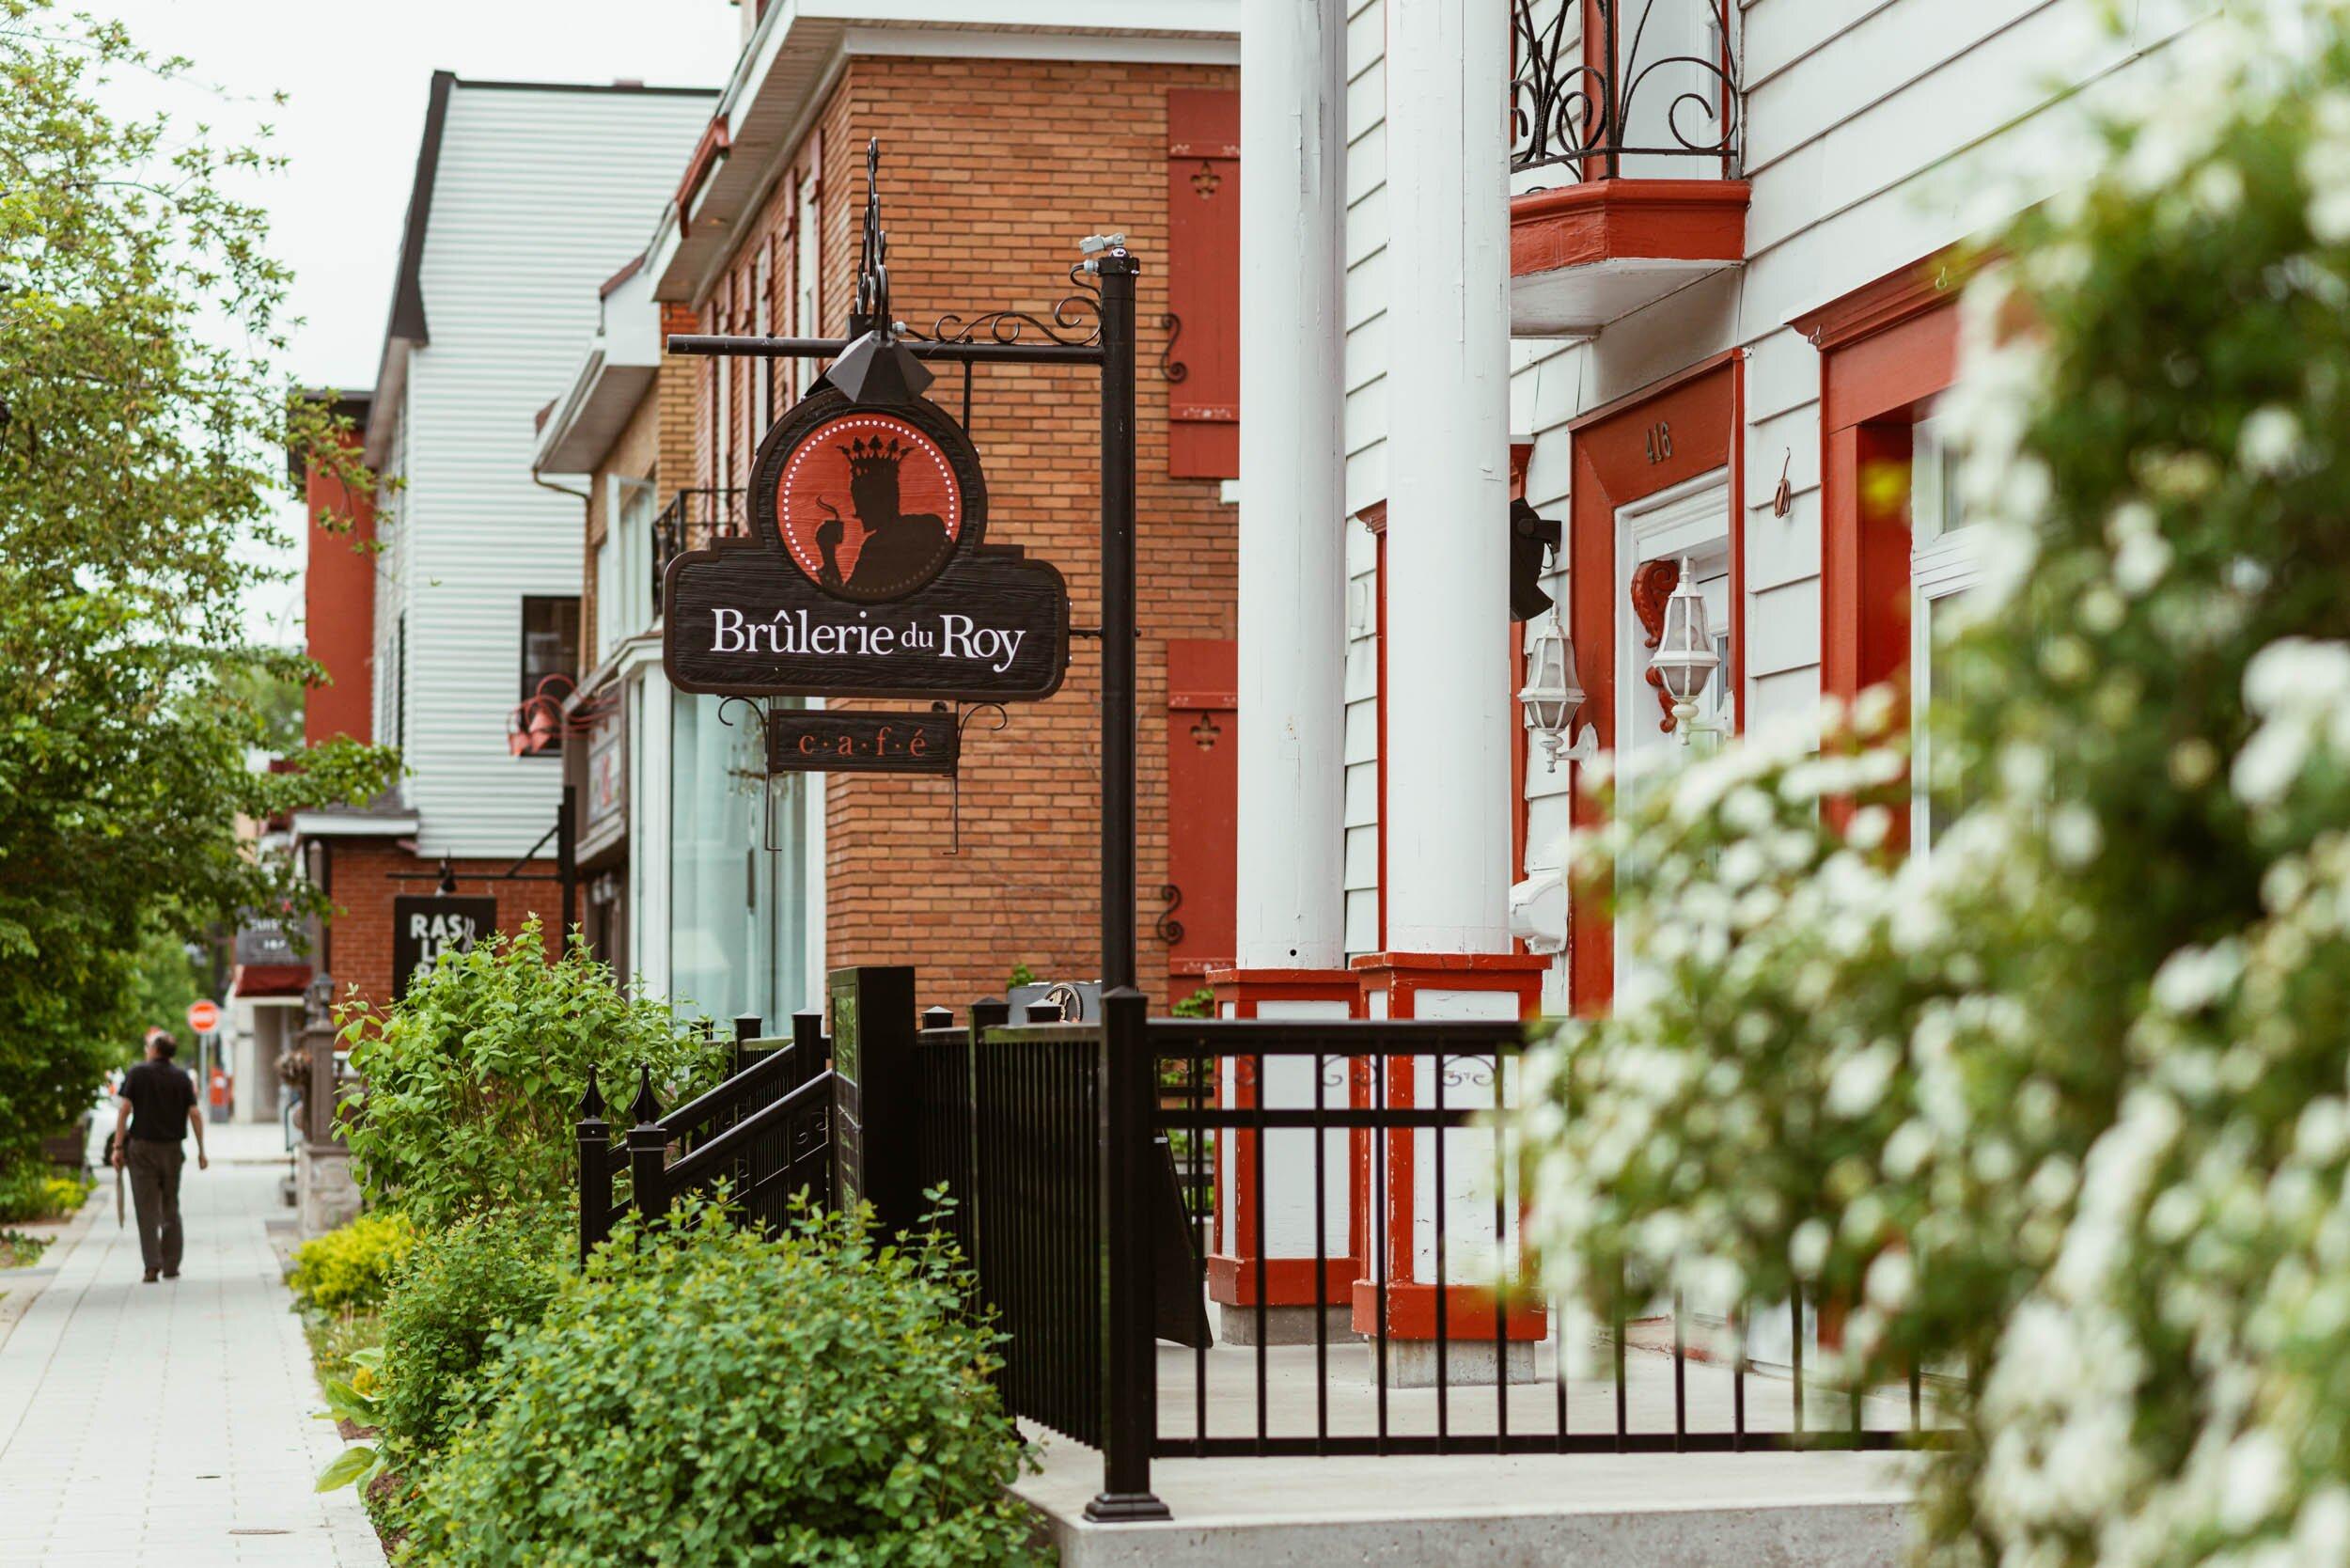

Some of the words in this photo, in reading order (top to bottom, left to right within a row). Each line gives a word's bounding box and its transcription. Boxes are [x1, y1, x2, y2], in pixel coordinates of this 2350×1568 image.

[1646, 422, 1671, 463] 416
[710, 608, 894, 655] Brûlerie
[901, 622, 933, 648] du
[939, 615, 1026, 673] Roy
[410, 914, 463, 939] RAS
